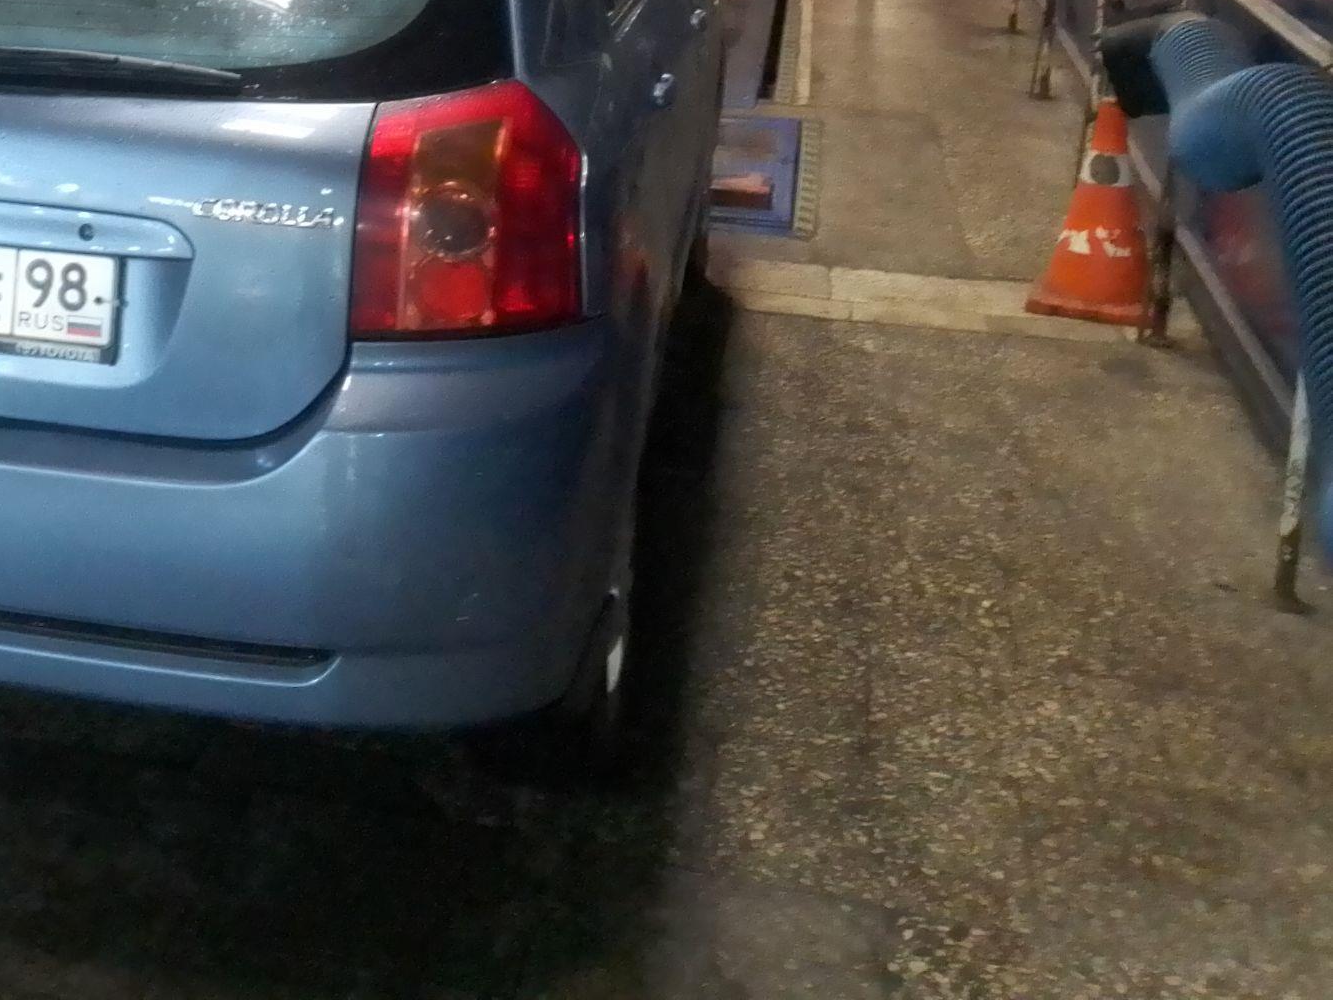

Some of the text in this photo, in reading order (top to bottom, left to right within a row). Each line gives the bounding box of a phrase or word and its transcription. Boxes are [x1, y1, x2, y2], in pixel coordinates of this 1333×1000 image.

[192, 198, 344, 228] COROLLA
[25, 258, 88, 312] 98
[18, 311, 65, 331] RUS
